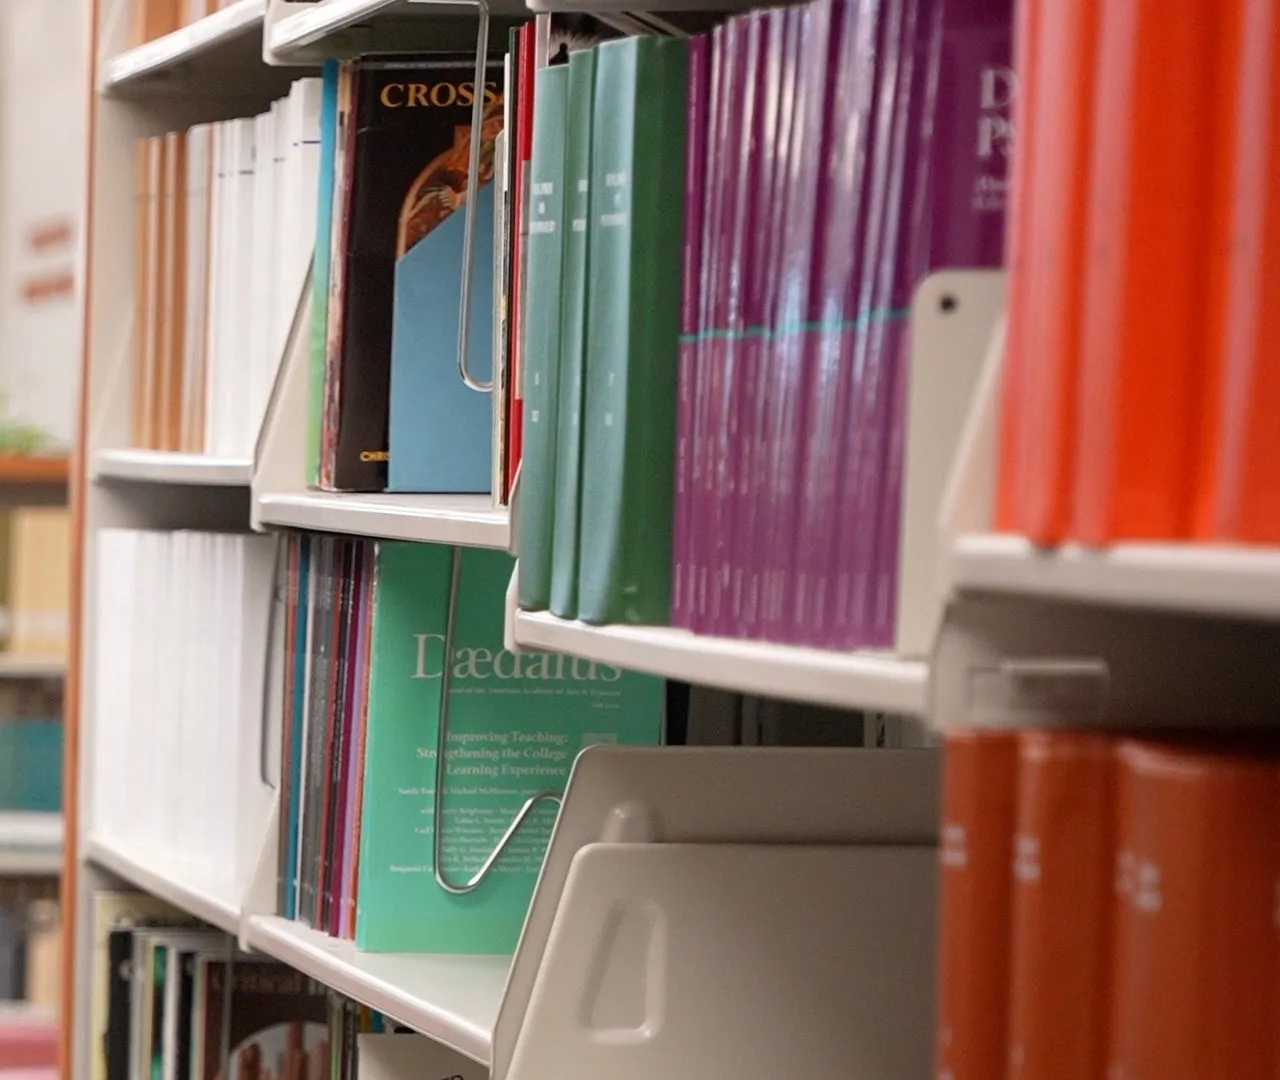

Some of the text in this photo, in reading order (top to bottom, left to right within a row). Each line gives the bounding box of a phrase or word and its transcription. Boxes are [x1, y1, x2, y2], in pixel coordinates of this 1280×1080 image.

[447, 732, 508, 744] Improving
[502, 748, 521, 758] the
[523, 748, 568, 760] College
[446, 765, 567, 777] Learning Experience
